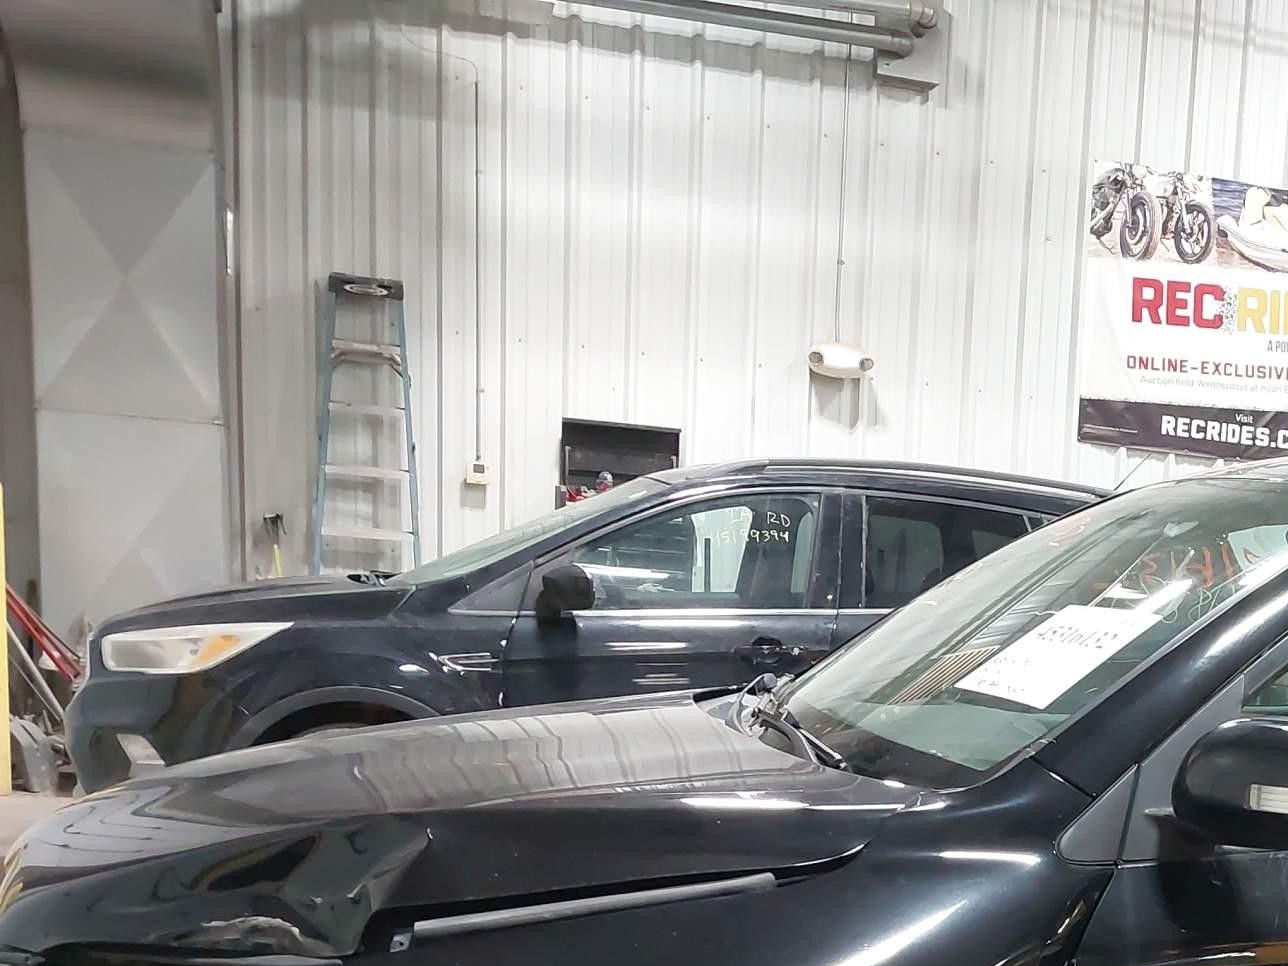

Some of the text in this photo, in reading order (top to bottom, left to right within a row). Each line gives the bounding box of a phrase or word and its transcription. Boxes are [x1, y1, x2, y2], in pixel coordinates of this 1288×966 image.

[1131, 276, 1226, 330] REC
[1267, 339, 1274, 352] A
[1235, 413, 1254, 423] Visit
